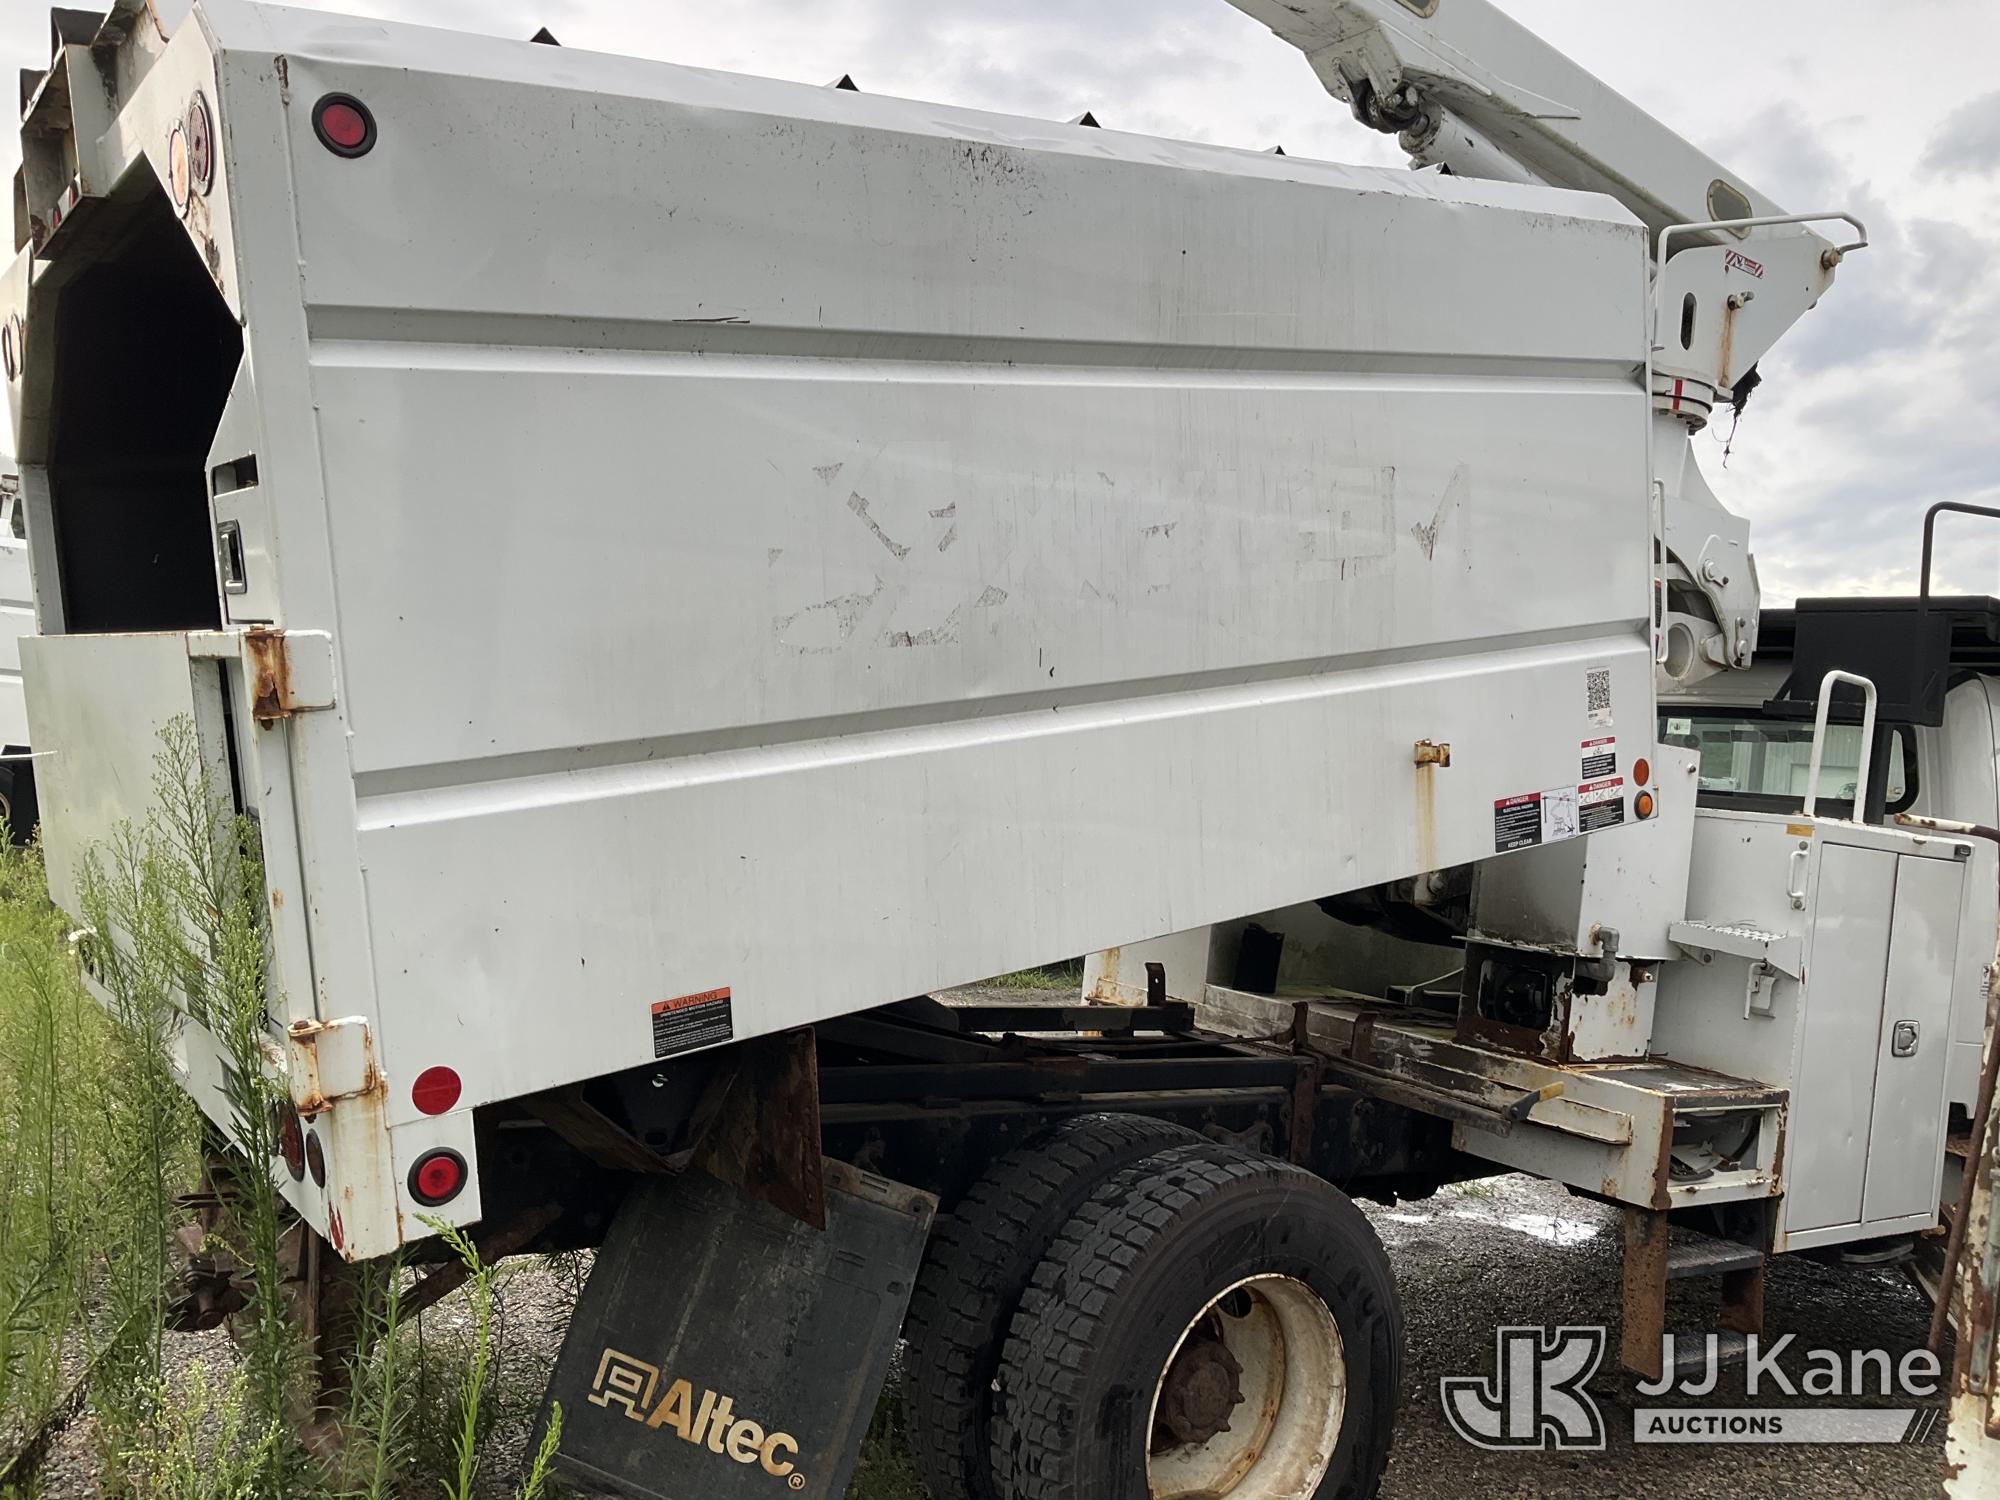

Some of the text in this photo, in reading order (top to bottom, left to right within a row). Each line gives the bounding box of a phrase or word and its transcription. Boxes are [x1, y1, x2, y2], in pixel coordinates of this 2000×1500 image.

[1593, 781, 1612, 790] DANGER
[1510, 795, 1529, 805] DANGER
[1519, 838, 1533, 846] CLEAR
[673, 992, 718, 1008] WARNING
